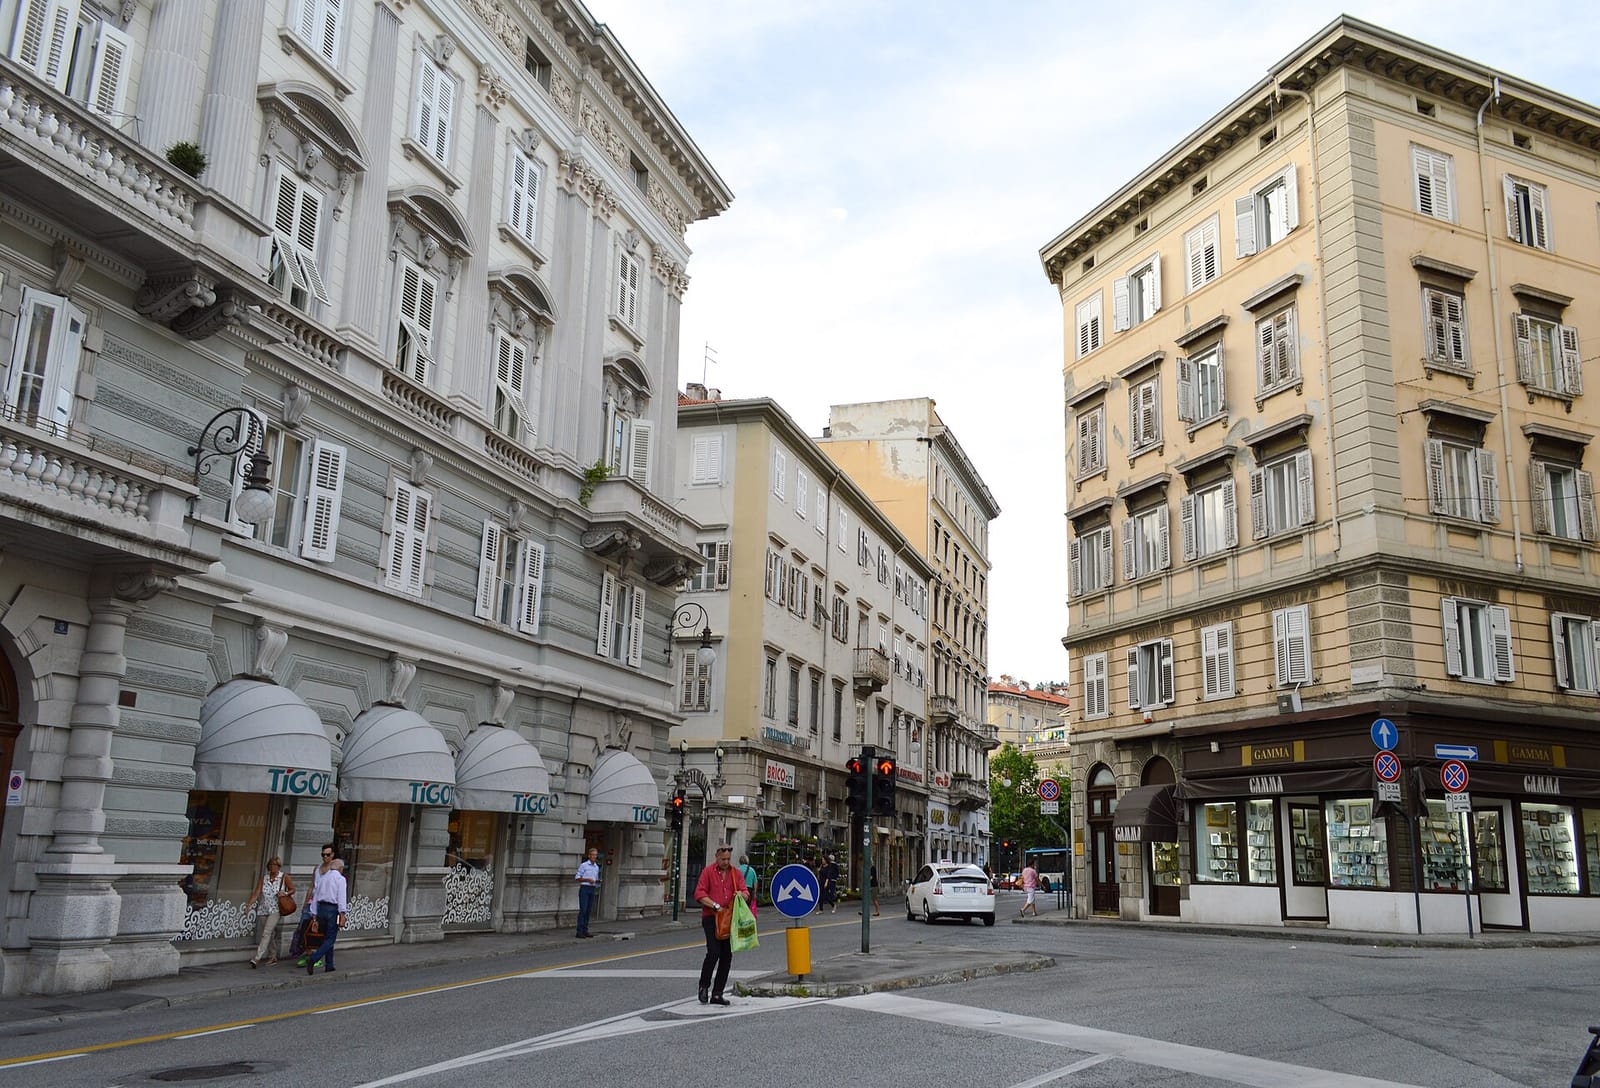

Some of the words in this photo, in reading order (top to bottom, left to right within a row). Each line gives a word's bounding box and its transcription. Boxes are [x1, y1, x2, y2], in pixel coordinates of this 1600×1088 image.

[1254, 747, 1290, 760] GAMMA
[1511, 746, 1550, 761] GAMMA
[1249, 775, 1284, 793] GAMMA
[1523, 775, 1560, 795] GAMMA
[1115, 826, 1141, 841] GAMMA
